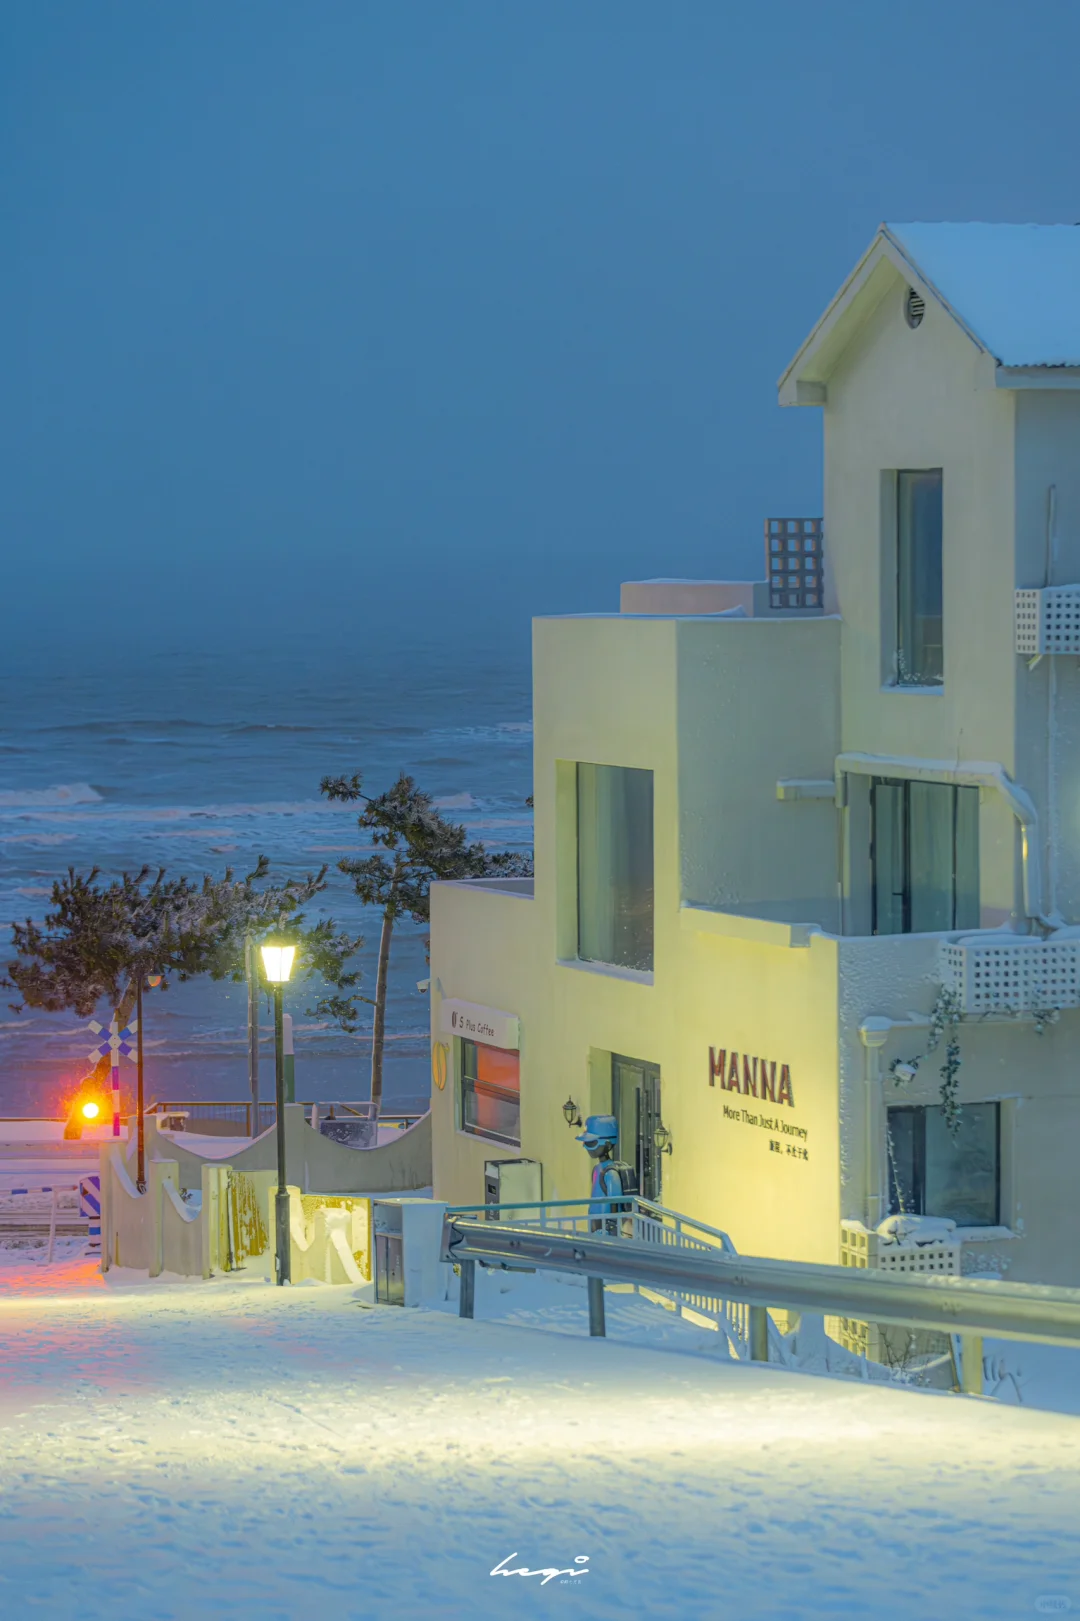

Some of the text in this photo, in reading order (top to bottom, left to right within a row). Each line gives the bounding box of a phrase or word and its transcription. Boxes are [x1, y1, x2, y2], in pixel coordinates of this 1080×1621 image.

[466, 1018, 476, 1032] Plus
[477, 1022, 494, 1037] Coffee
[708, 1046, 795, 1108] MANNA
[723, 1105, 808, 1142] More Than Just A Journey
